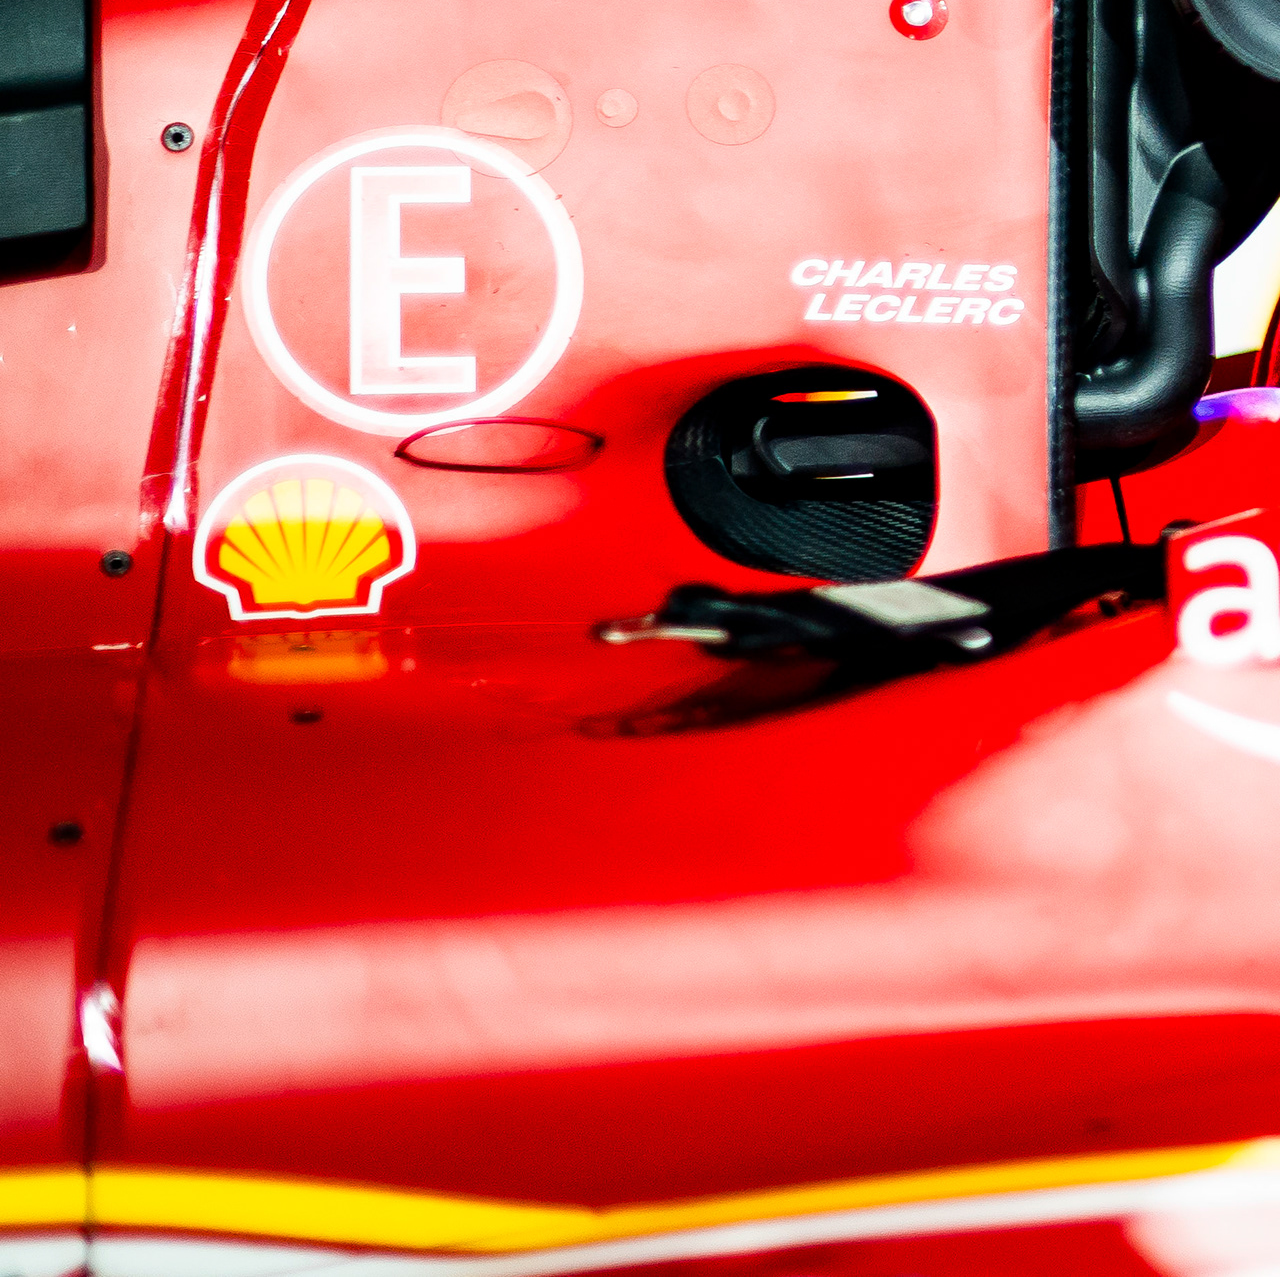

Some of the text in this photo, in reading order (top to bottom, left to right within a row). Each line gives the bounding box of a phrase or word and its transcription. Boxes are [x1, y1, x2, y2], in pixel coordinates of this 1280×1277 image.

[350, 165, 477, 395] E
[791, 258, 1019, 292] CHARLES
[803, 293, 1026, 326] LECLERC
